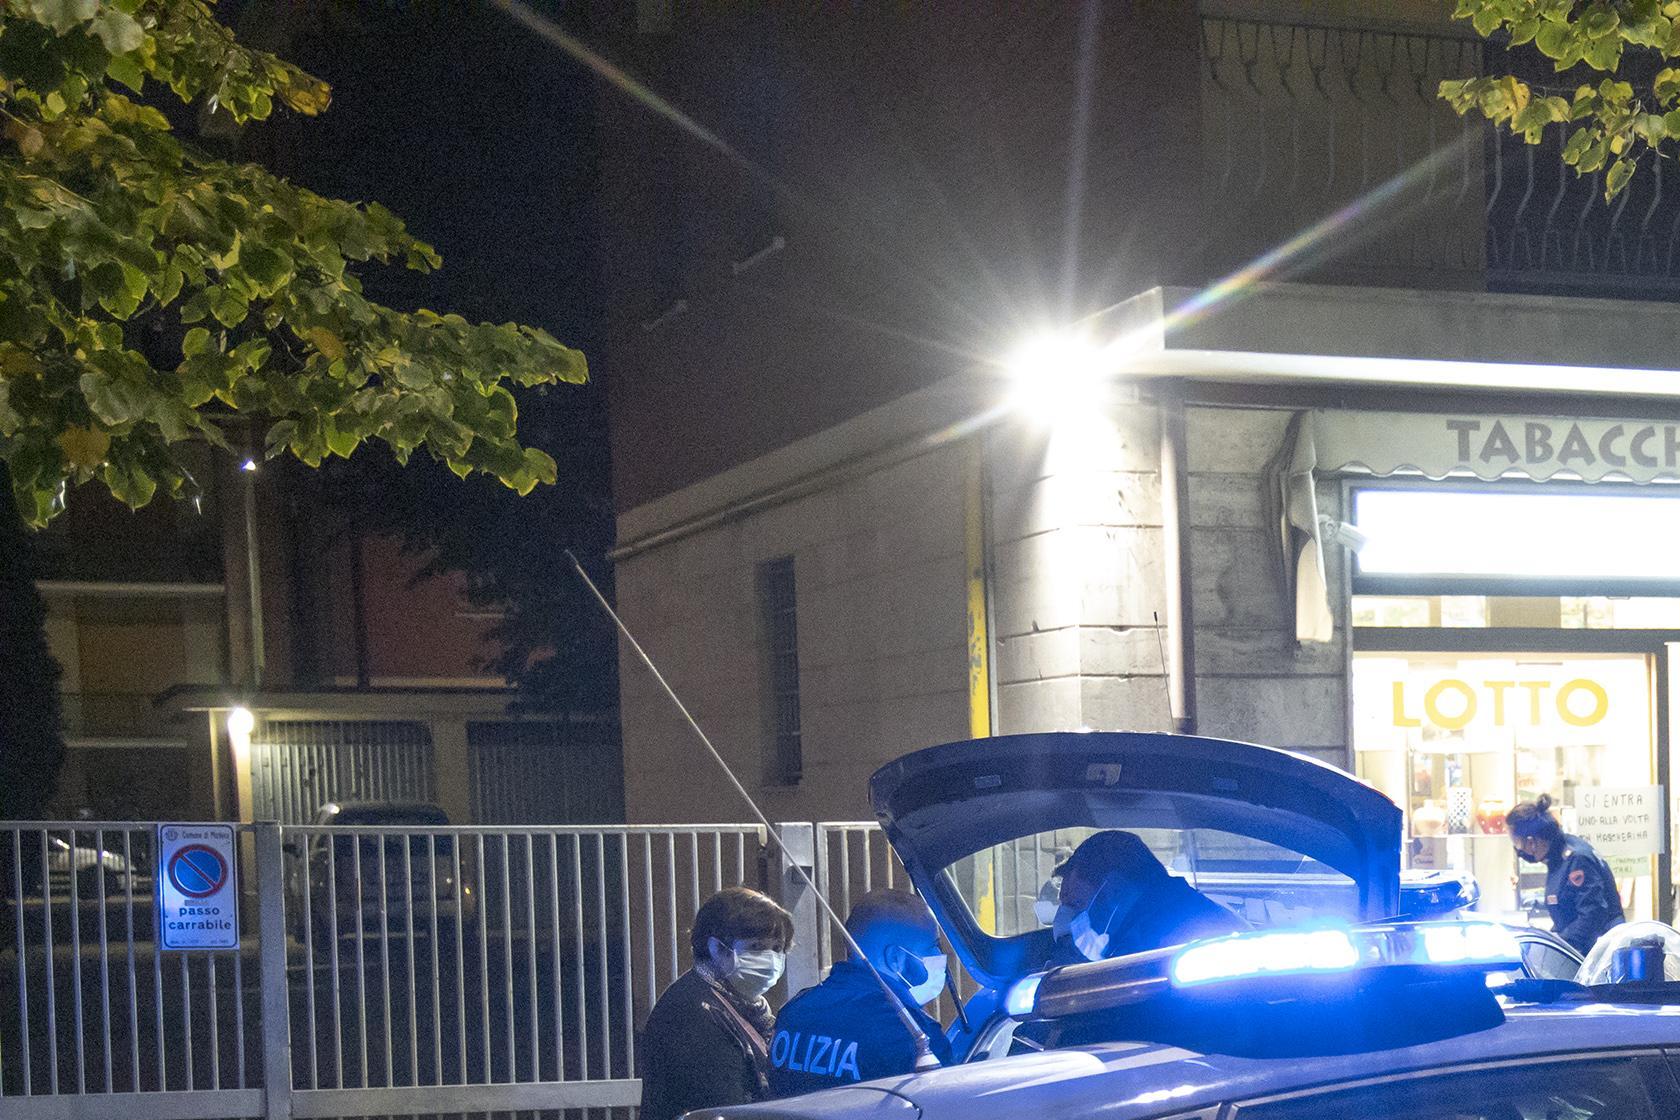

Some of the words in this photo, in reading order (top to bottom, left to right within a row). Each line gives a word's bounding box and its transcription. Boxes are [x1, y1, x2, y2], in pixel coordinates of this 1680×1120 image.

[1392, 678, 1609, 730] LOTTO
[1584, 793, 1597, 809] SI
[1603, 793, 1643, 809] ENTRA
[1600, 815, 1618, 826] ALLA
[1622, 813, 1650, 825] VOLTA
[179, 906, 220, 918] passo
[168, 919, 232, 931] carrabile
[770, 1030, 861, 1081] OLIZIA
